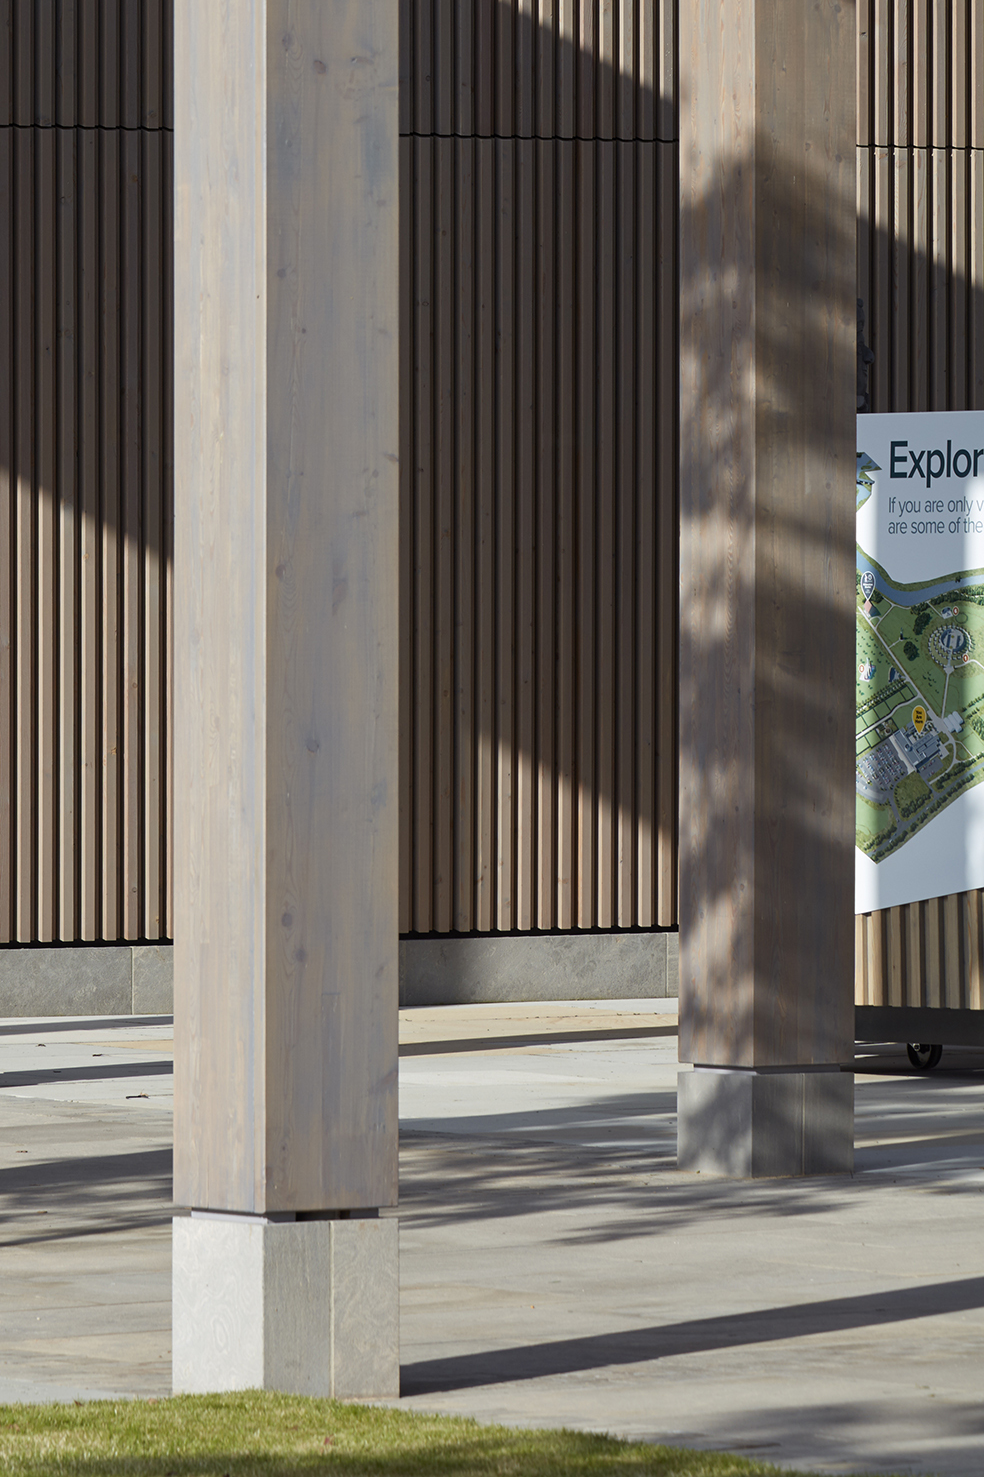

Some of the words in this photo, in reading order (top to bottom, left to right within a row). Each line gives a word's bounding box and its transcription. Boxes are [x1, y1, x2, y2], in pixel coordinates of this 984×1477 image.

[890, 440, 984, 488] Explor
[888, 496, 896, 513] If
[898, 500, 921, 517] you
[924, 500, 944, 513] are
[947, 496, 973, 516] only
[888, 521, 907, 534] are
[911, 521, 945, 534] some
[948, 517, 961, 533] of
[963, 517, 983, 533] the
